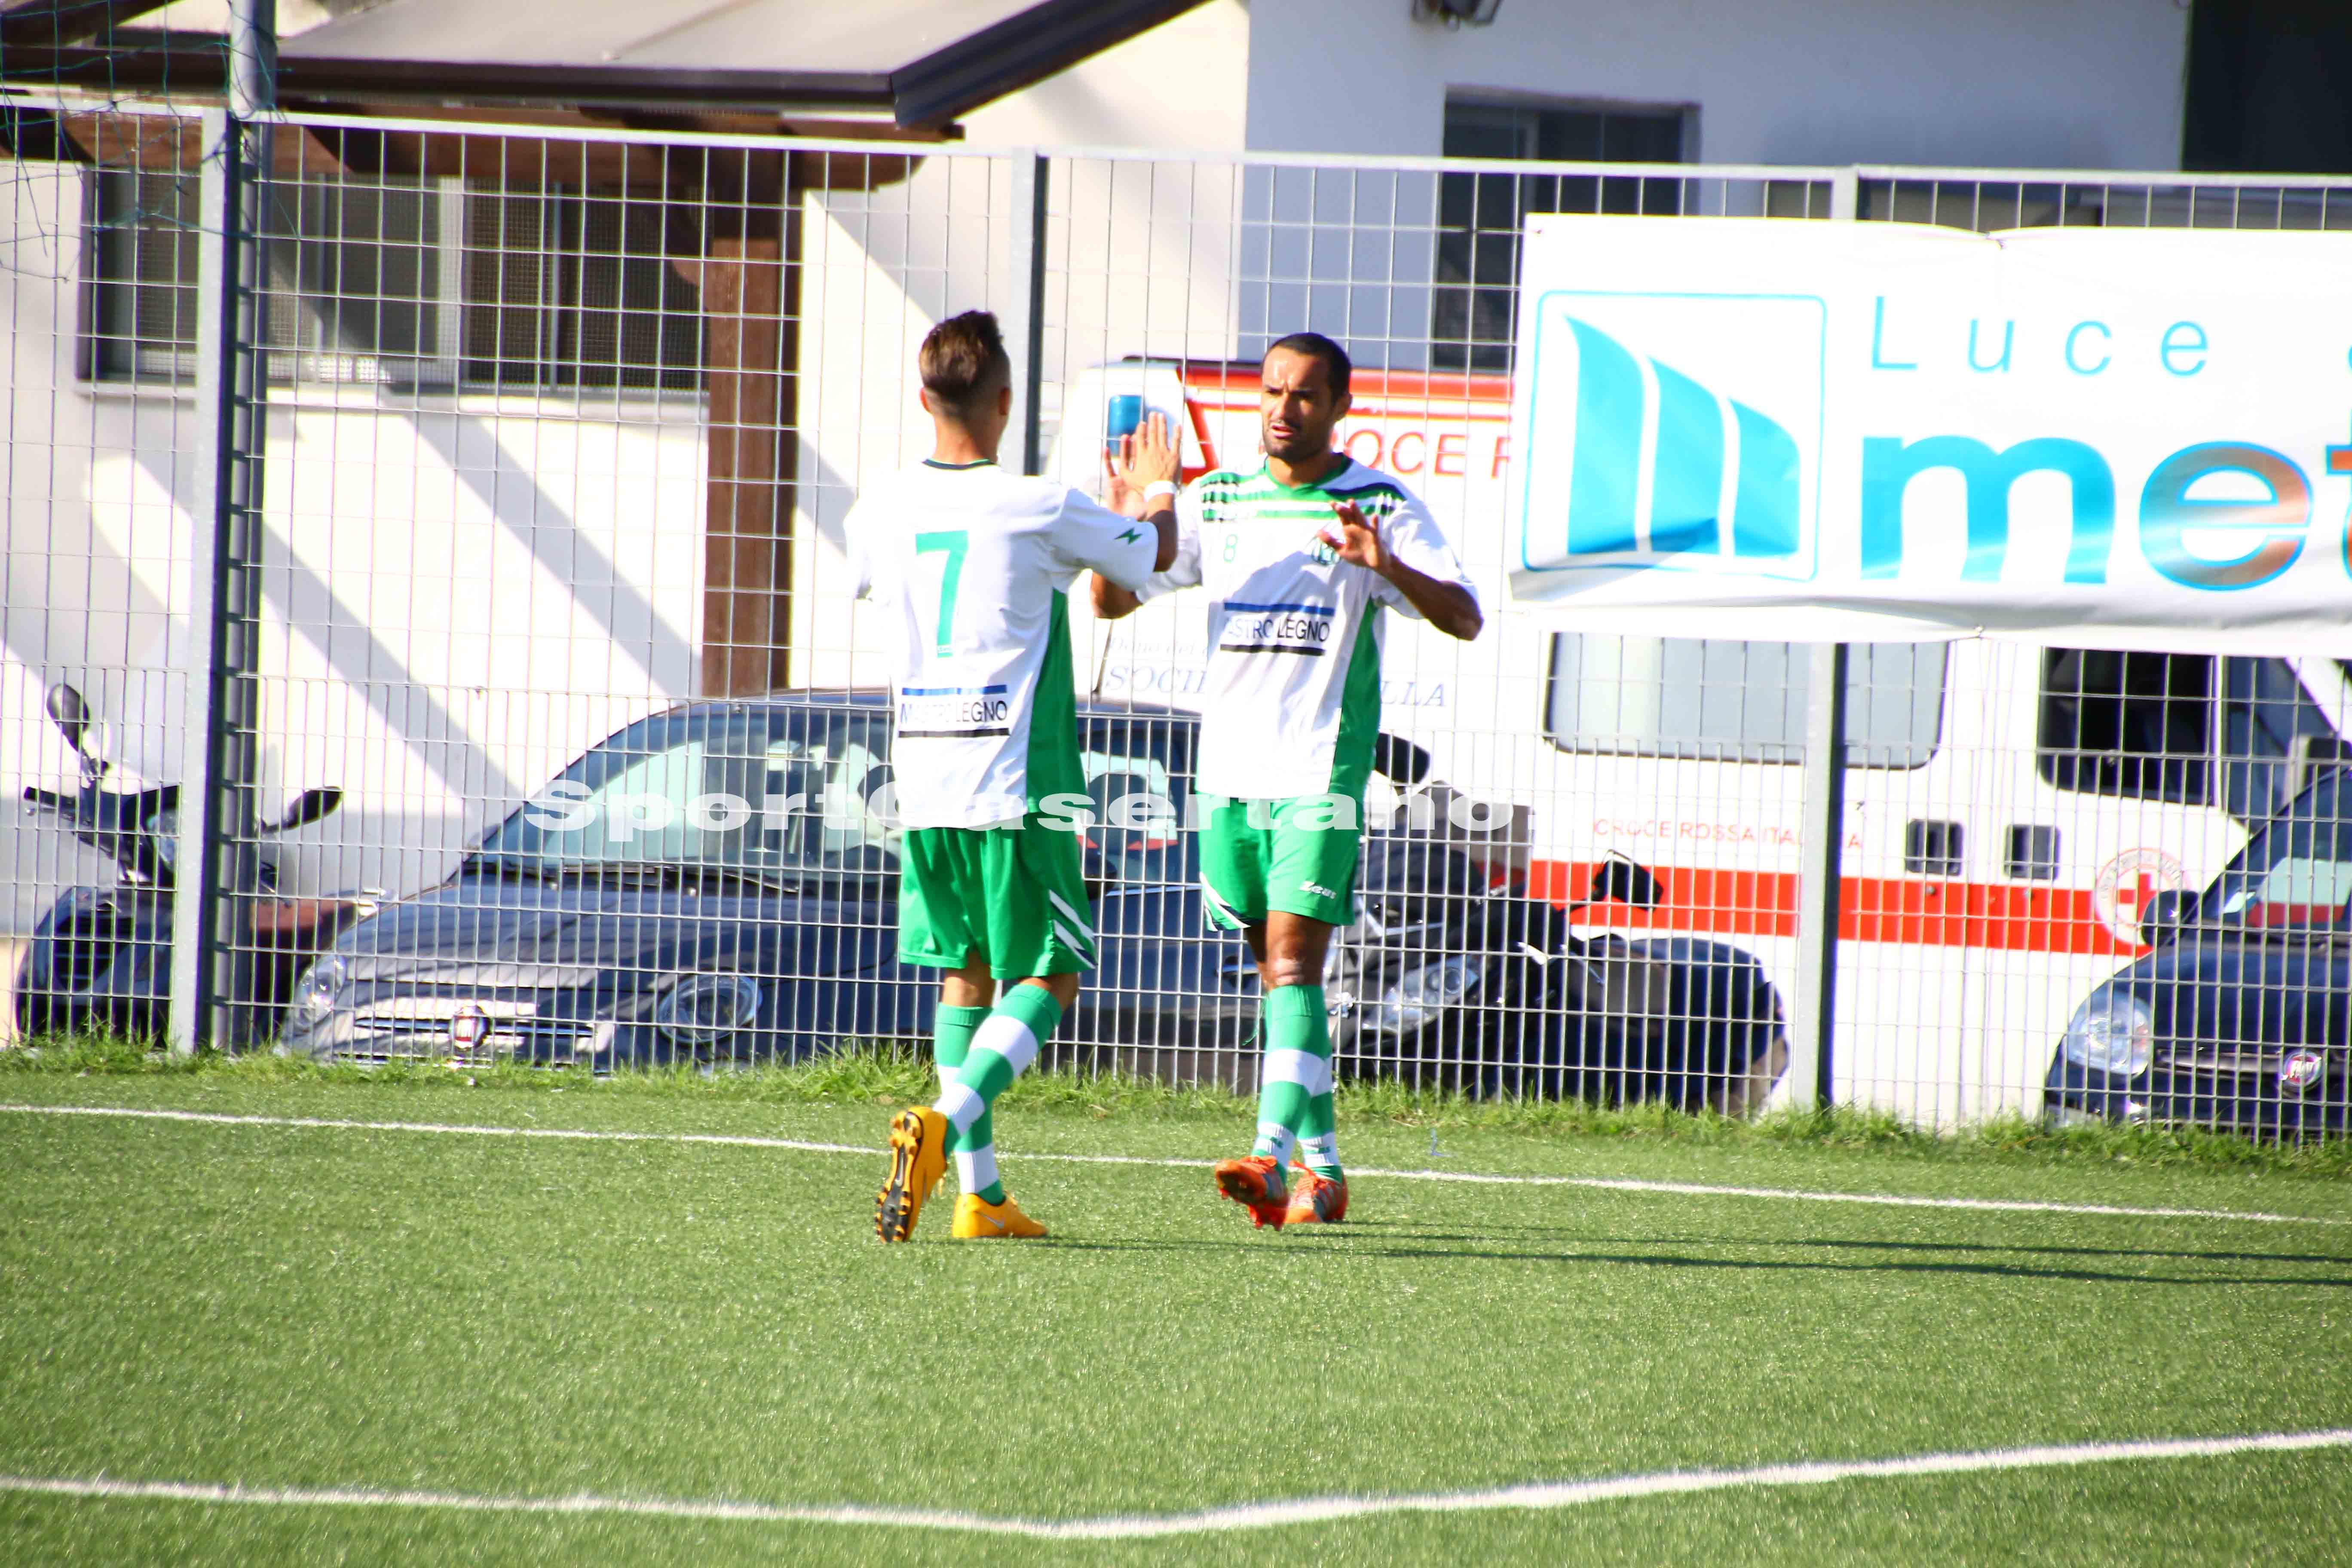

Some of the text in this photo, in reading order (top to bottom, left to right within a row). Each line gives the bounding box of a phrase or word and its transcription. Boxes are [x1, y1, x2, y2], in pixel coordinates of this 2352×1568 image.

[1871, 295, 2208, 377] Luce
[1223, 533, 1238, 564] 8
[915, 530, 968, 658] 7
[1277, 618, 1330, 642] LEGNO
[956, 700, 1007, 723] LEGNO
[1592, 818, 1671, 838] CROCE
[1680, 821, 1757, 842] ROSSA
